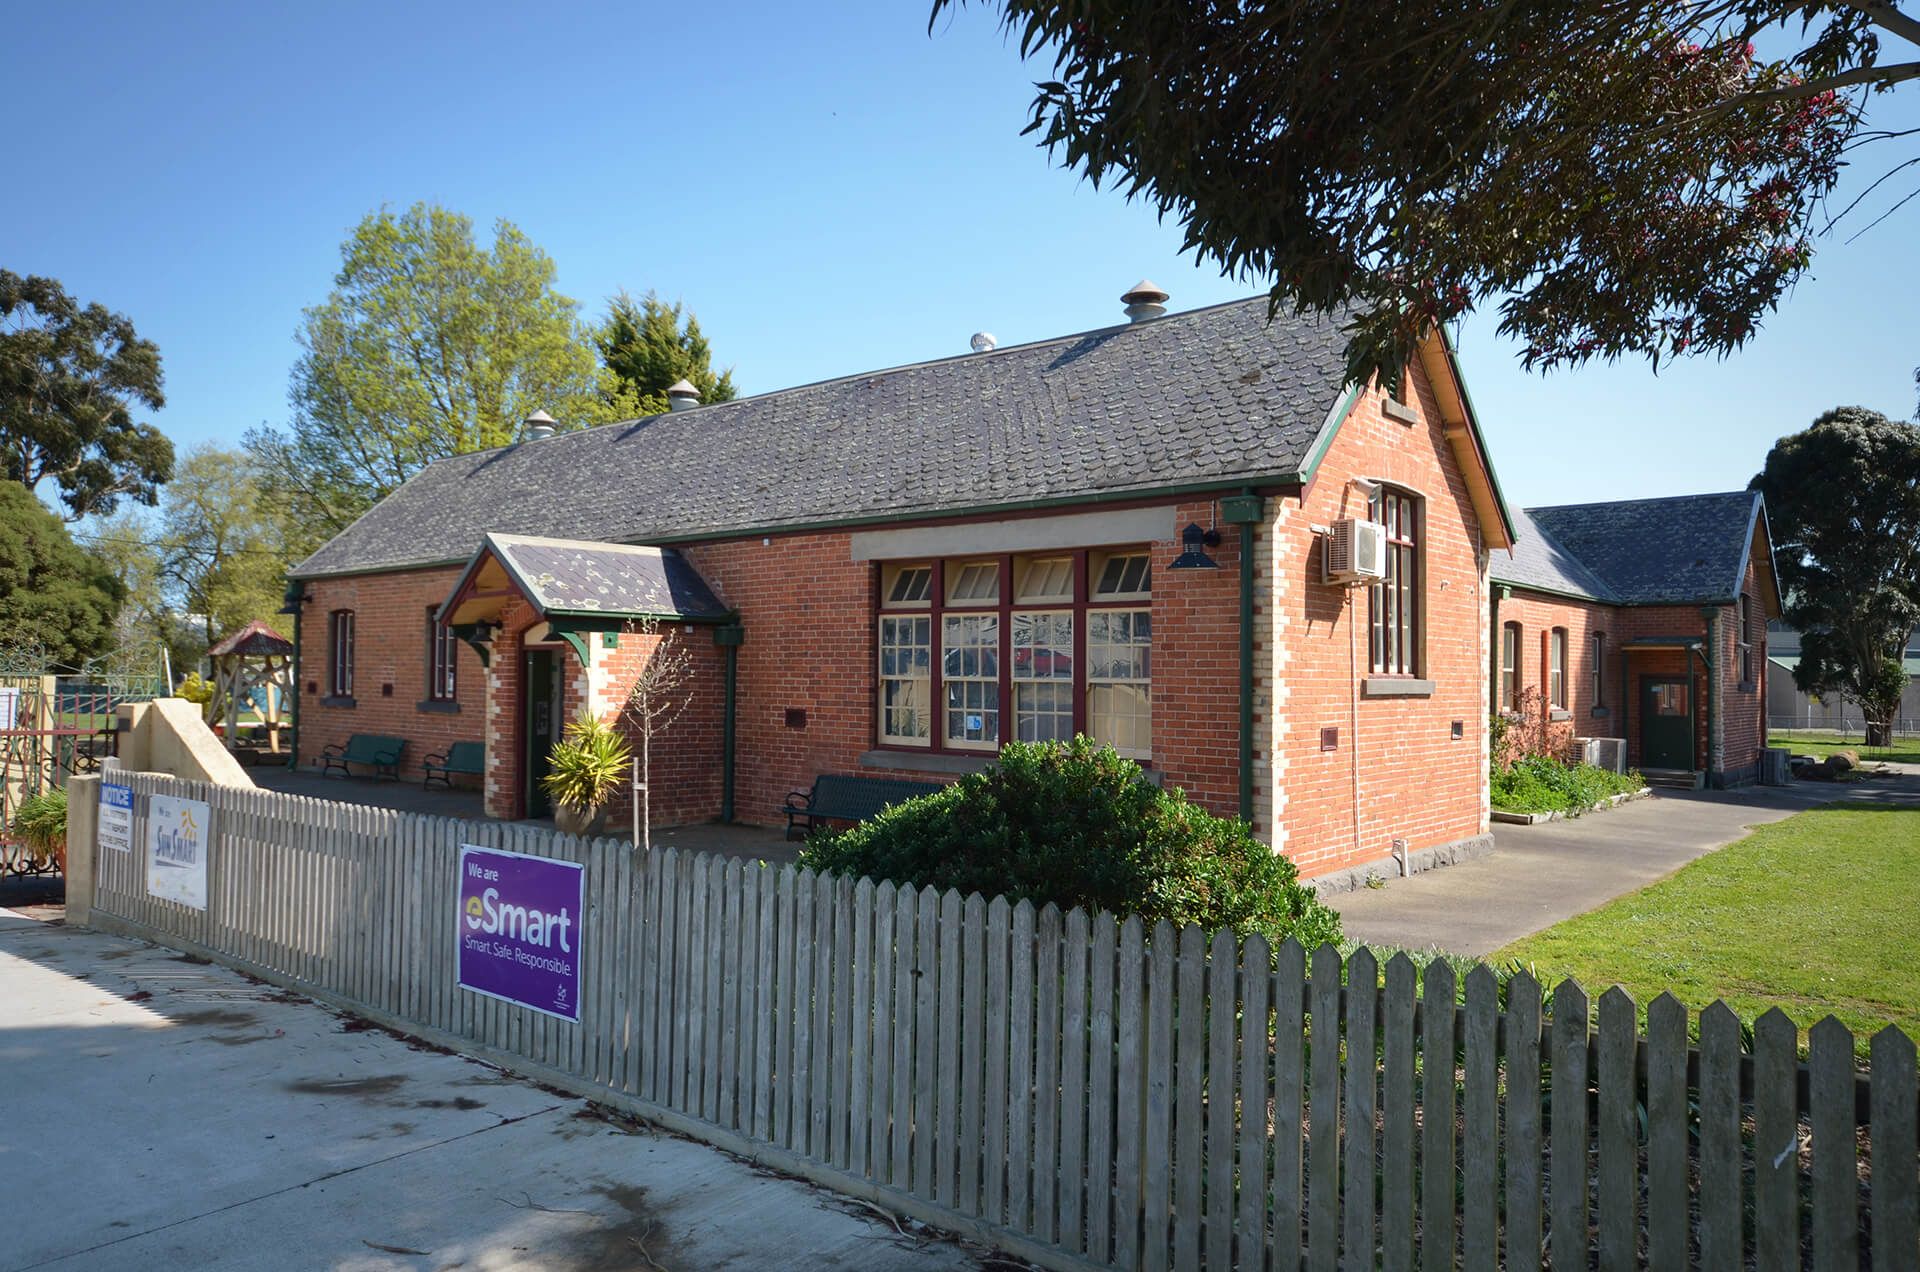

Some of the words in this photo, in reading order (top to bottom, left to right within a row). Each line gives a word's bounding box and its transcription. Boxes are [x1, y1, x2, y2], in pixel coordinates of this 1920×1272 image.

[102, 785, 129, 806] NOTICE
[468, 862, 482, 878] We
[483, 867, 499, 881] are
[465, 887, 571, 953] eSmart
[465, 934, 492, 955] Smart.
[493, 942, 514, 960] Safe.
[515, 947, 573, 977] Responsible.
